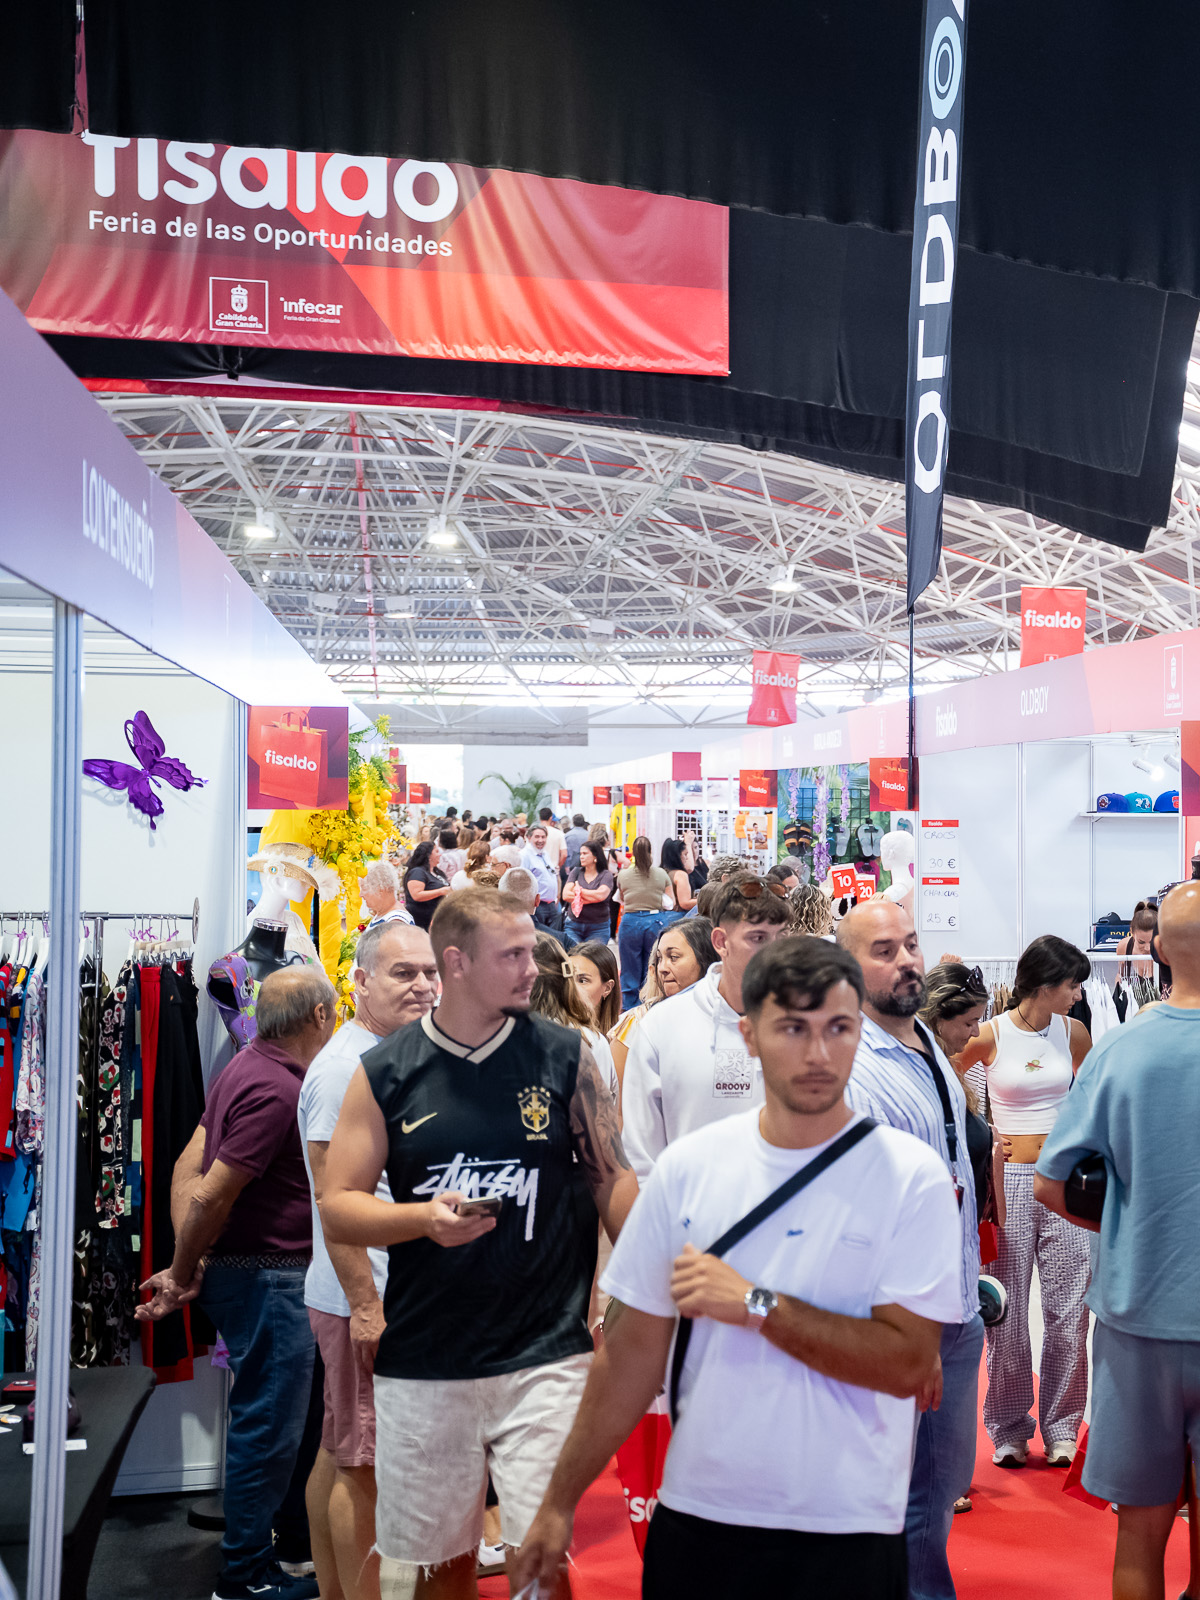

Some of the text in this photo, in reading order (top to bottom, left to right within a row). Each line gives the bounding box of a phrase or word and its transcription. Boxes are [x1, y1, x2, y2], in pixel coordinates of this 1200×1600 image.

[88, 210, 453, 257] Feria de las Oportunidades
[914, 0, 963, 493] OLDBO
[280, 297, 343, 316] infecar
[215, 319, 263, 328] Gran Canaria
[218, 313, 247, 322] Cabildo
[1024, 609, 1082, 629] fisaldo
[754, 670, 797, 688] fisaldo
[1020, 685, 1049, 717] OLDBOY
[264, 749, 317, 772] fisaldo
[881, 780, 906, 792] fisaldo
[924, 831, 955, 840] CROCS
[947, 858, 956, 869] €
[837, 875, 852, 888] 10
[859, 886, 873, 898] 20
[927, 913, 956, 927] 25 €
[715, 1082, 751, 1091] GROOVY
